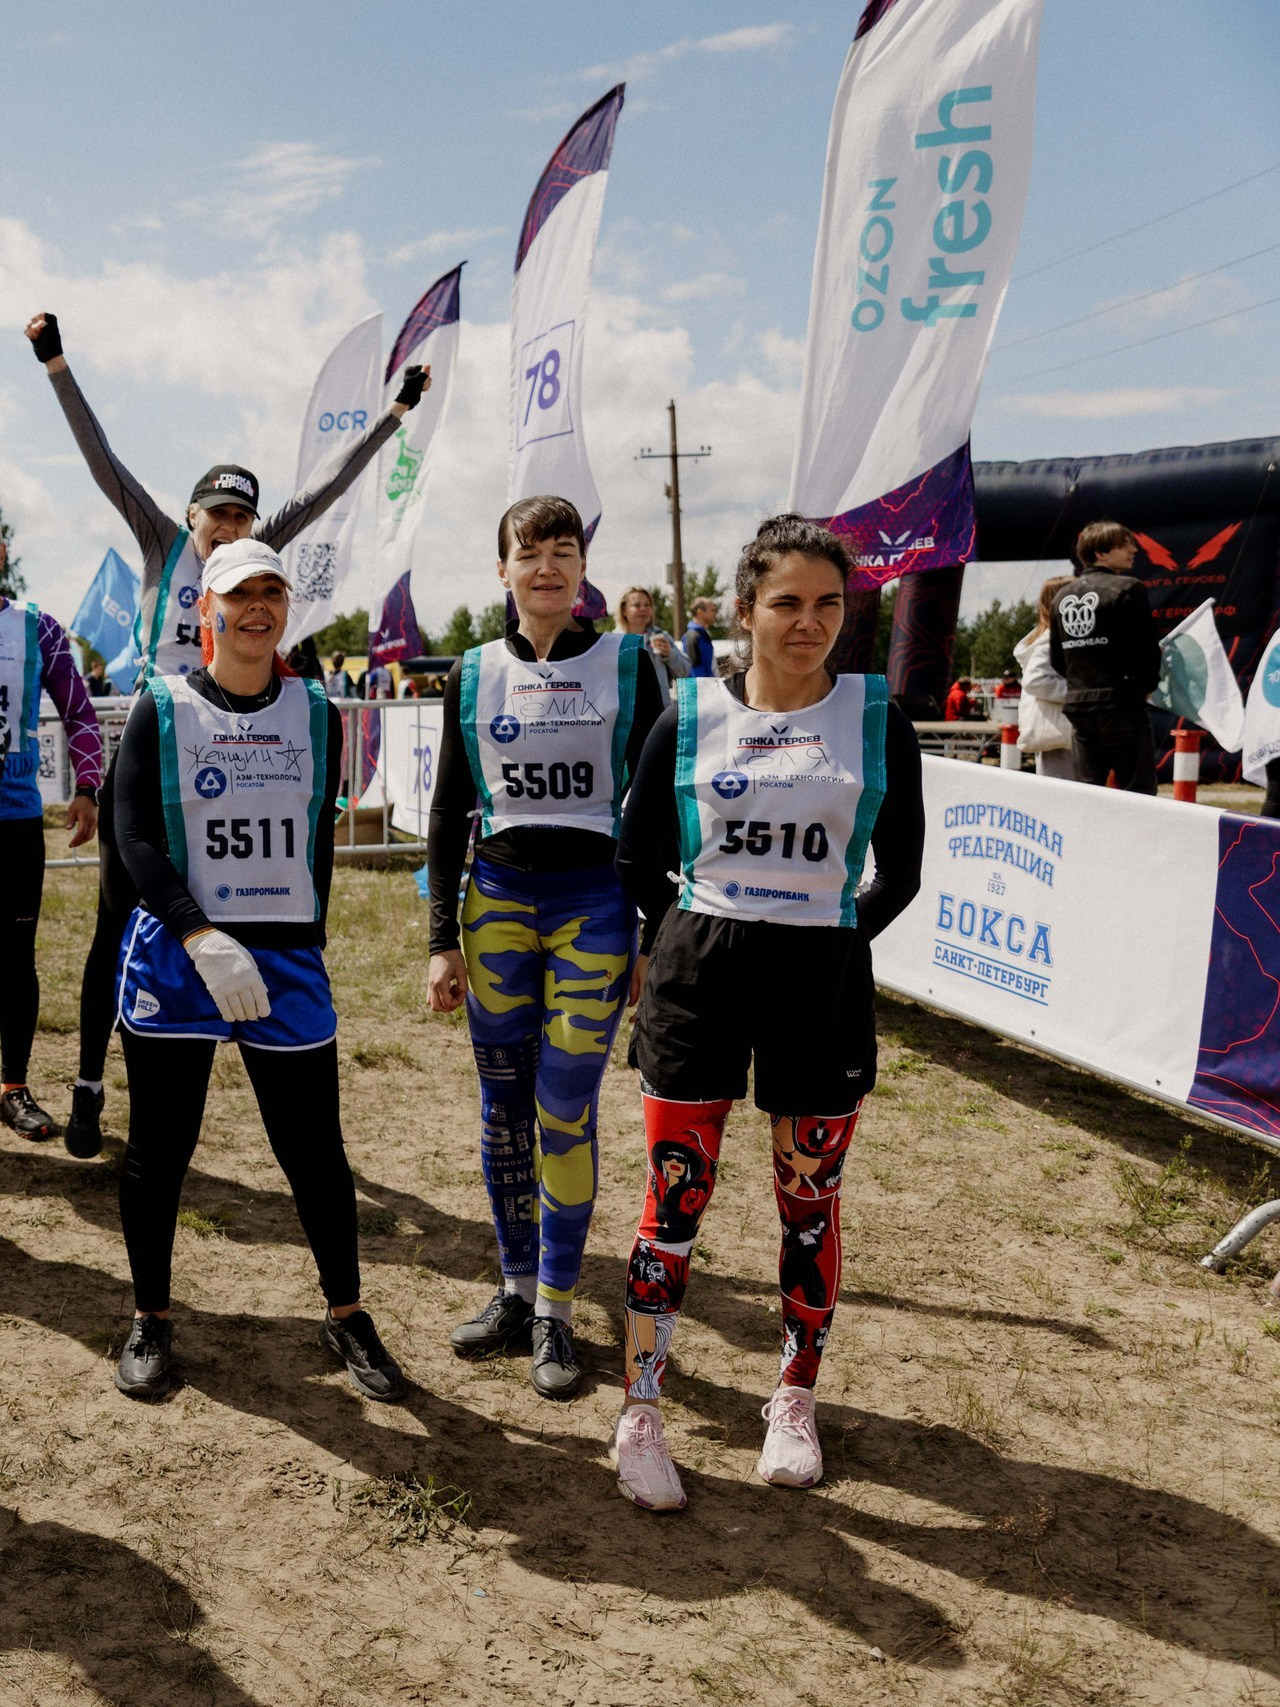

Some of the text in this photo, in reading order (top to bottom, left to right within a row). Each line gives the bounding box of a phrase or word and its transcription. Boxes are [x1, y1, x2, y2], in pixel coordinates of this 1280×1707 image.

[901, 85, 993, 328] fresh
[852, 177, 897, 332] OZON
[524, 348, 560, 427] 78
[318, 410, 367, 432] OCR
[513, 681, 582, 692] ГОНКА ГЕРОЕВ
[213, 733, 280, 742] ГОНКА ГЕРОЕВ
[739, 735, 821, 746] ГОНКА ГЕРОЕВ
[236, 774, 301, 783] АЭМ-ТЕХНОЛОГИИ
[502, 761, 594, 800] 5509
[760, 774, 845, 784] АЭМ-ТЕХНОЛОГИИ
[206, 818, 294, 860] 5511
[719, 820, 829, 862] 5510
[944, 803, 1064, 858] СПОРТИВНАЯ
[948, 835, 1055, 888] ФЕДЕРАЦИЯ
[235, 886, 290, 897] ГАЗПРОМБАНК
[745, 886, 810, 901] ГАЗПРОМБАНК
[987, 882, 1006, 896] 1927
[936, 891, 1053, 967] БОКСА
[935, 945, 1049, 998] САНКТ-ПЕТЕРБУРГ
